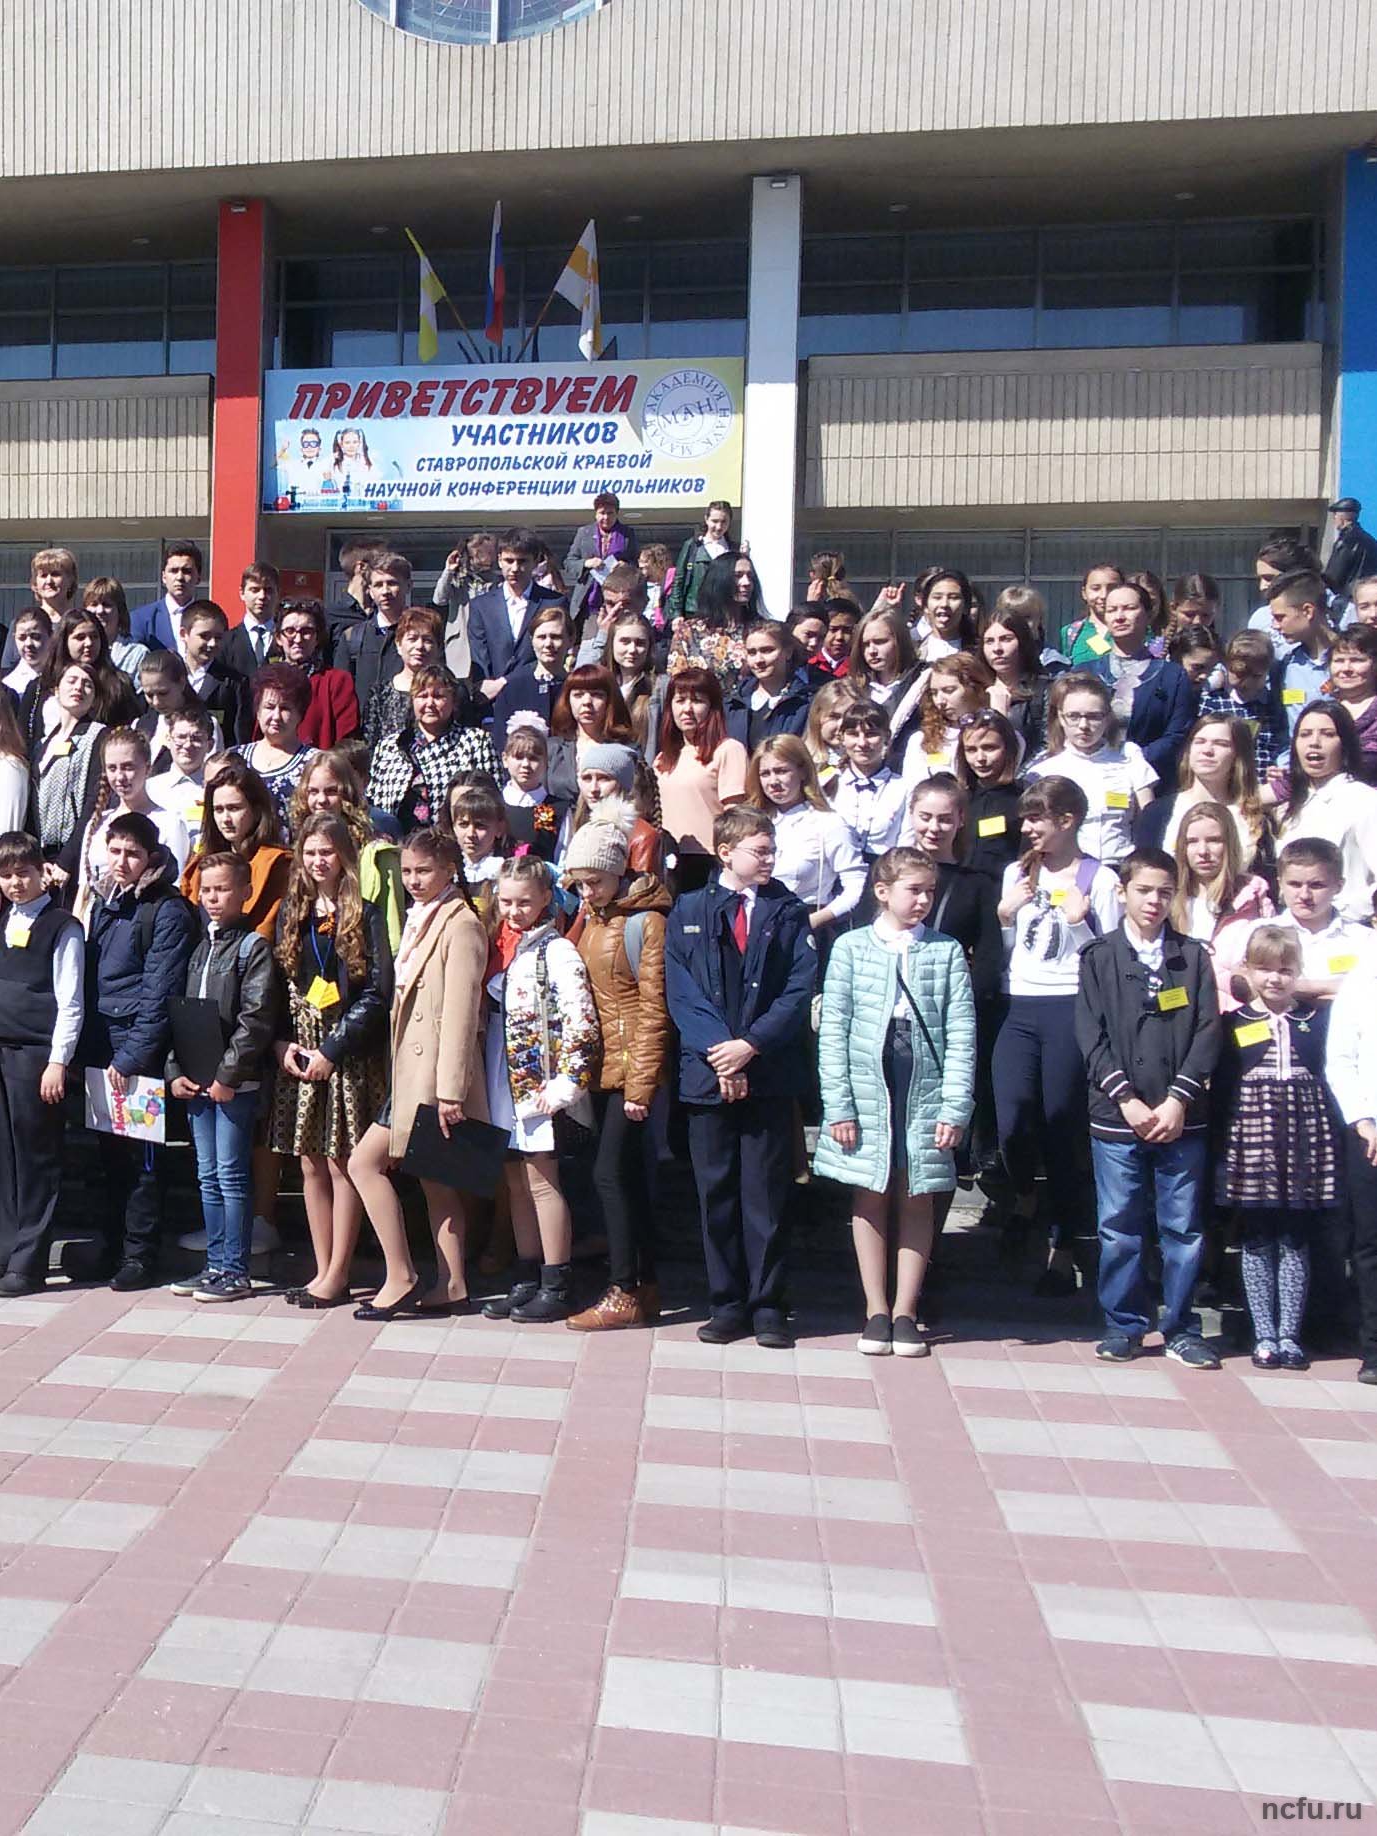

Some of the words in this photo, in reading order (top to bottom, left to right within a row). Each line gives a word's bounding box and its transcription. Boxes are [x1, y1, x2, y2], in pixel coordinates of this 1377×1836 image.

[288, 374, 638, 420] ПРИВЕТСТВУЕМ
[646, 372, 726, 413] АКАДЕМИЯ
[661, 397, 713, 425] МАН
[451, 421, 619, 447] УЧАСТНИКОВ
[416, 451, 568, 473] СТАВРОПОЛЬСКОЙ
[572, 449, 653, 471] КРАЕВОЙ
[364, 479, 441, 498] НАУЧНОЙ
[446, 480, 577, 498] КОНФЕРЕНЦИИ
[582, 478, 706, 496] ШКОЛЬНИКОВ
